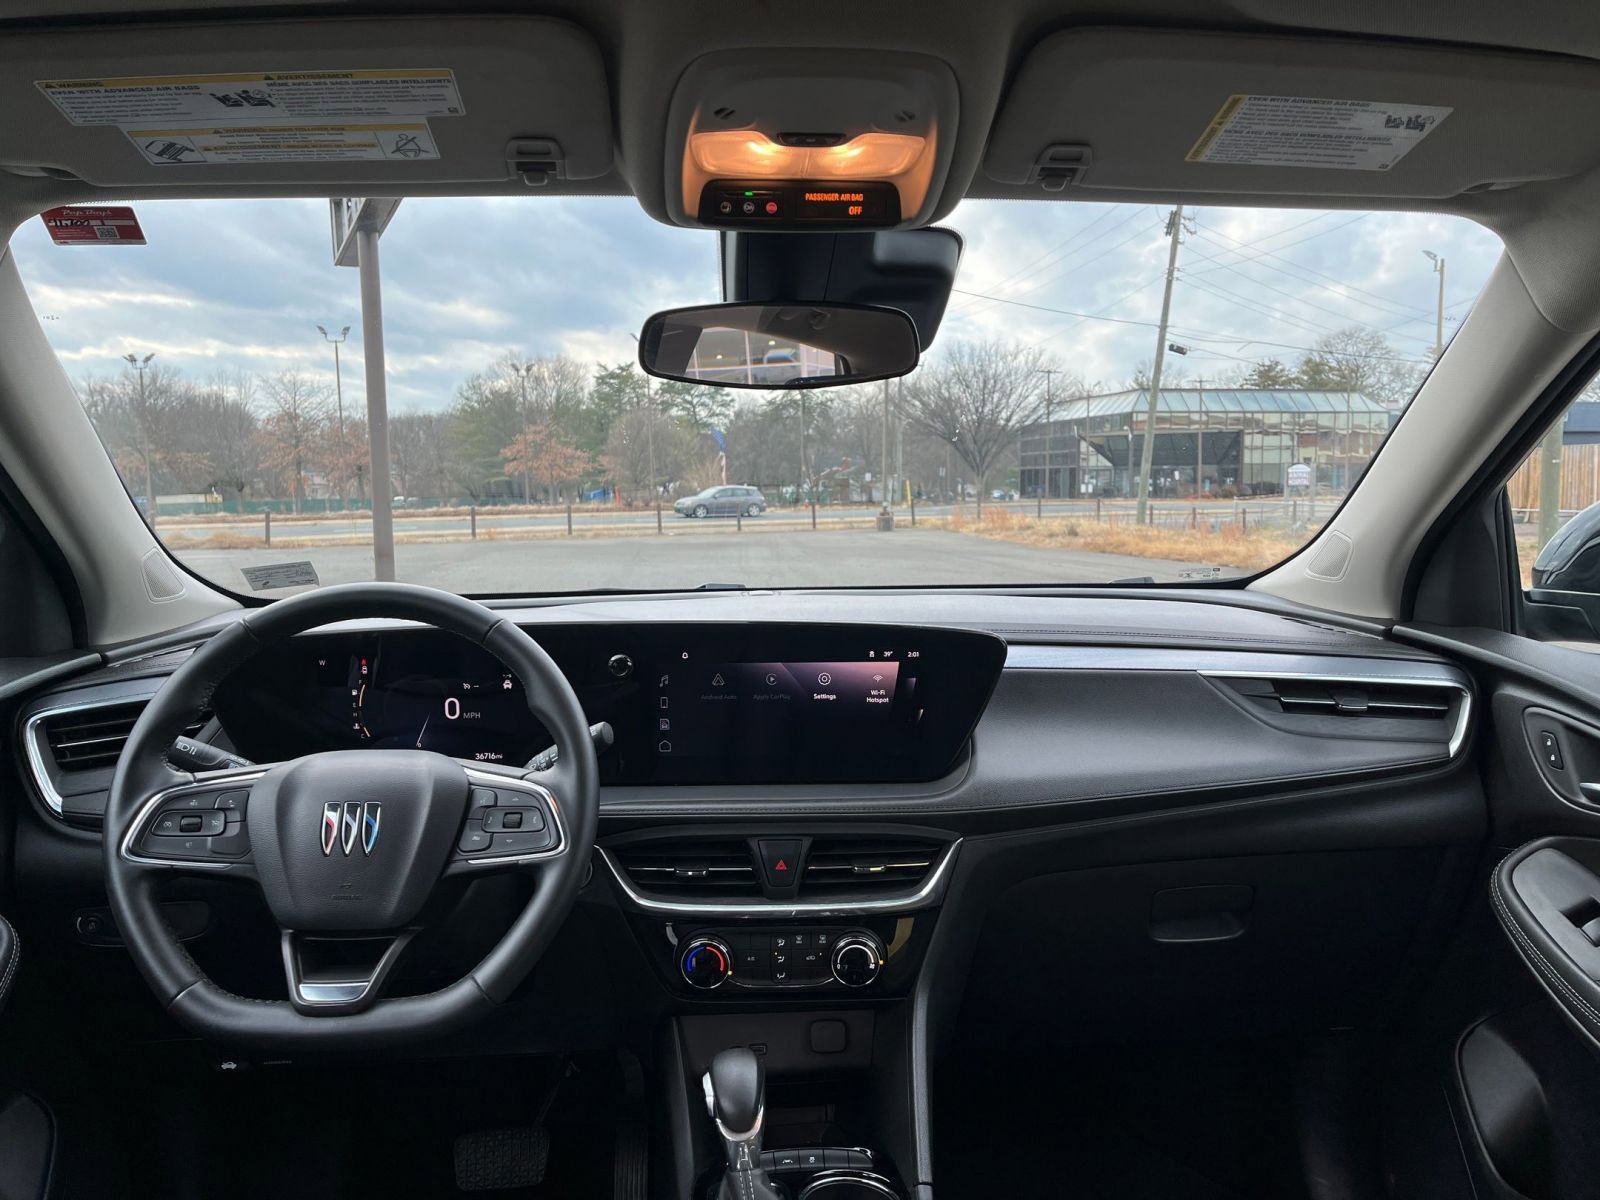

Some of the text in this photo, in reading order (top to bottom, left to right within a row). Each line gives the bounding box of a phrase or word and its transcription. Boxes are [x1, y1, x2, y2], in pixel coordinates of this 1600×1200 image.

[805, 193, 863, 201] PASSENGER AIR BAG
[848, 206, 863, 216] OFF
[813, 693, 837, 701] Settings
[866, 696, 889, 704] Hotspot
[444, 697, 461, 720] 0
